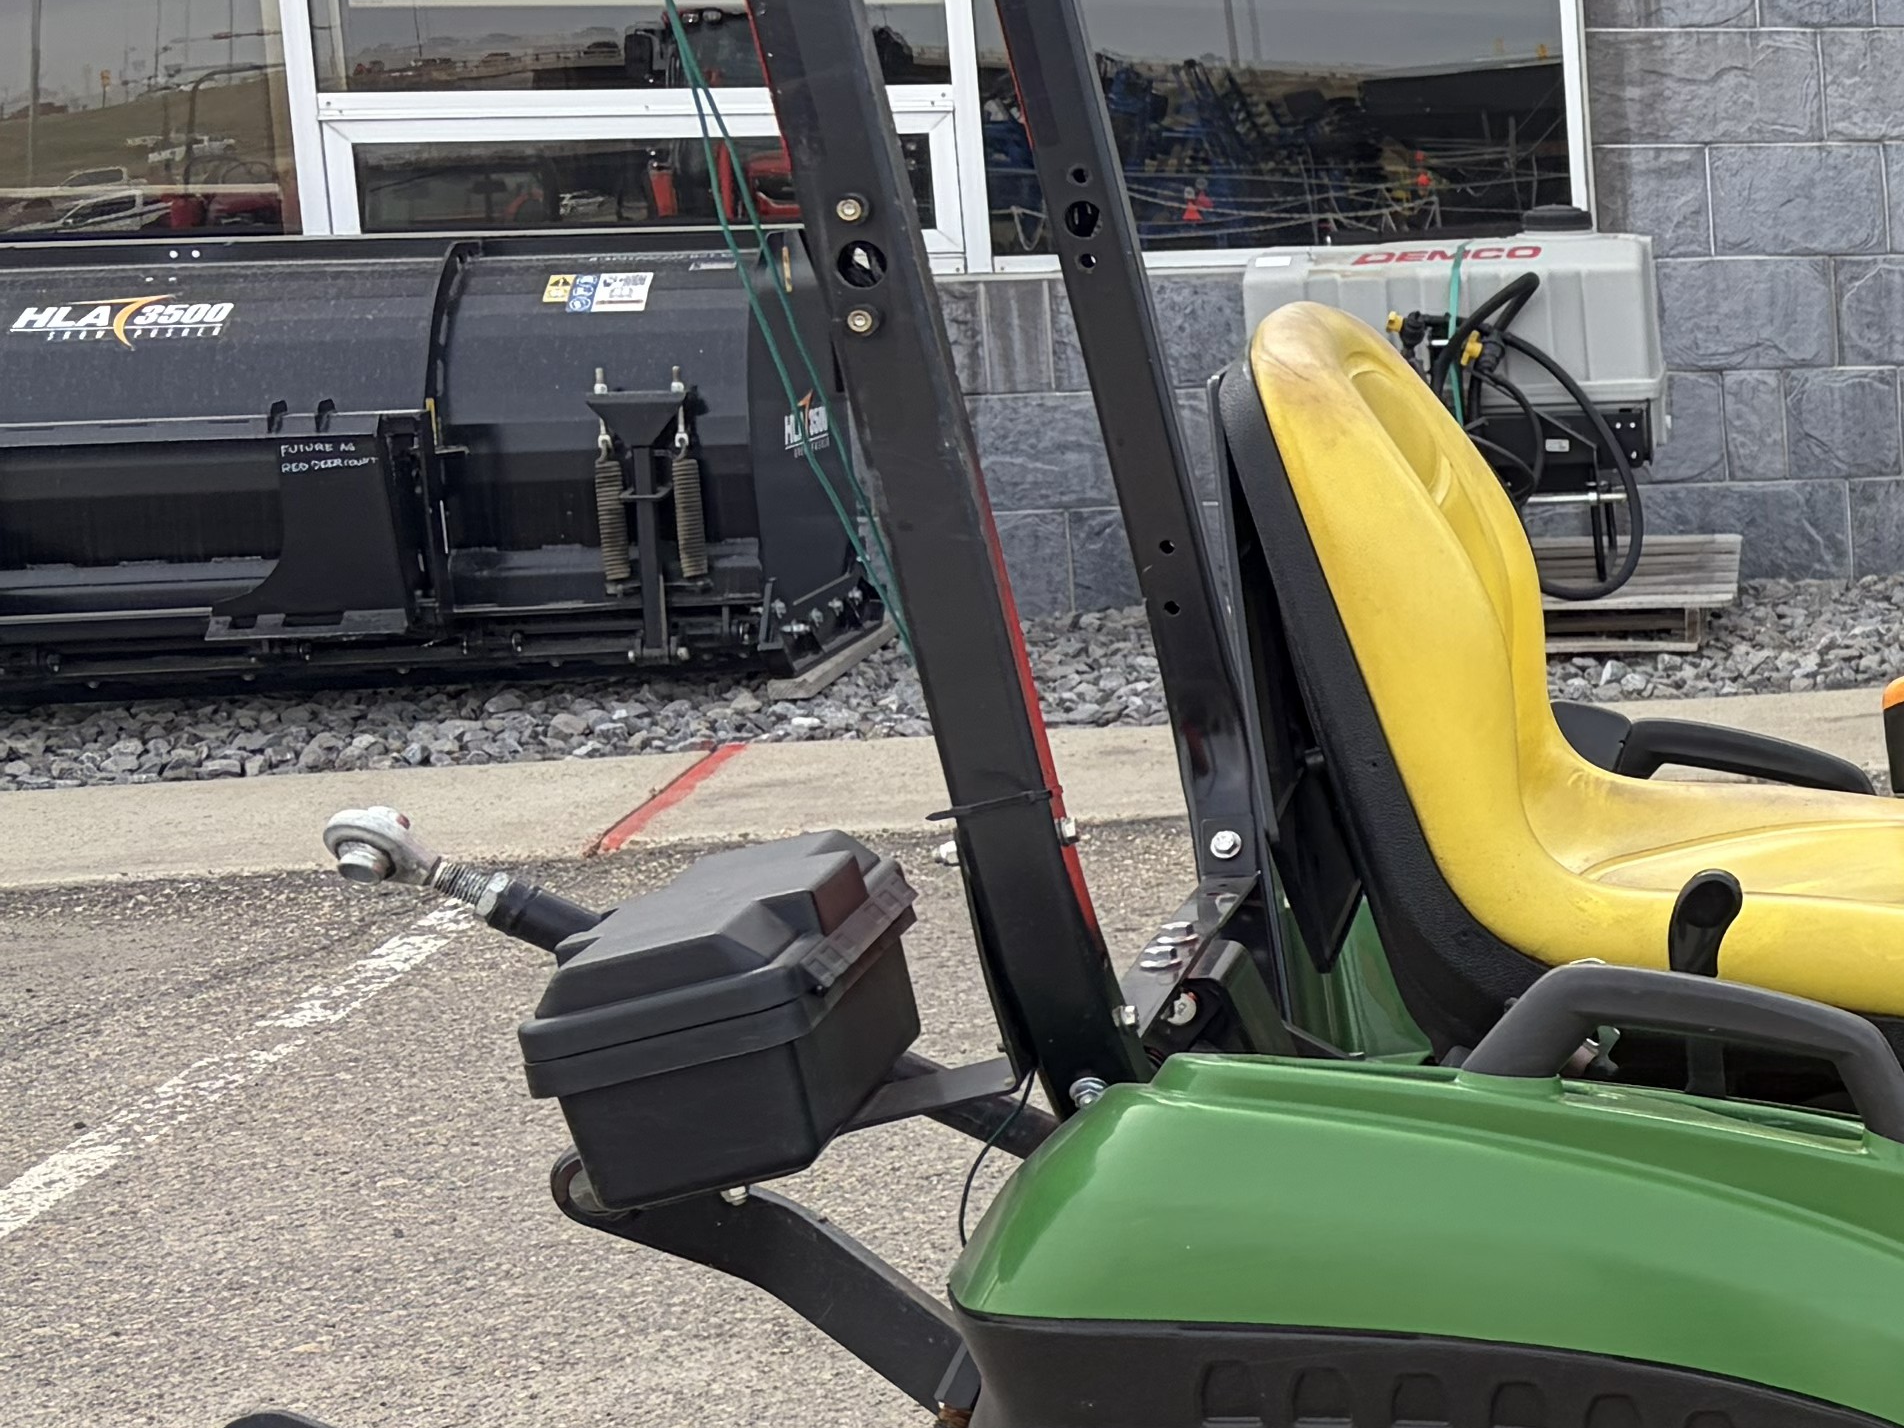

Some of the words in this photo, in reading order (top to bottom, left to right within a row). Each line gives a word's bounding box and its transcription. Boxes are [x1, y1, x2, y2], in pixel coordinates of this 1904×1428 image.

[1351, 246, 1542, 265] DEMCO
[12, 305, 111, 329] HLA
[133, 303, 235, 325] 3500
[280, 442, 333, 457] FUTURE
[281, 462, 309, 473] RED
